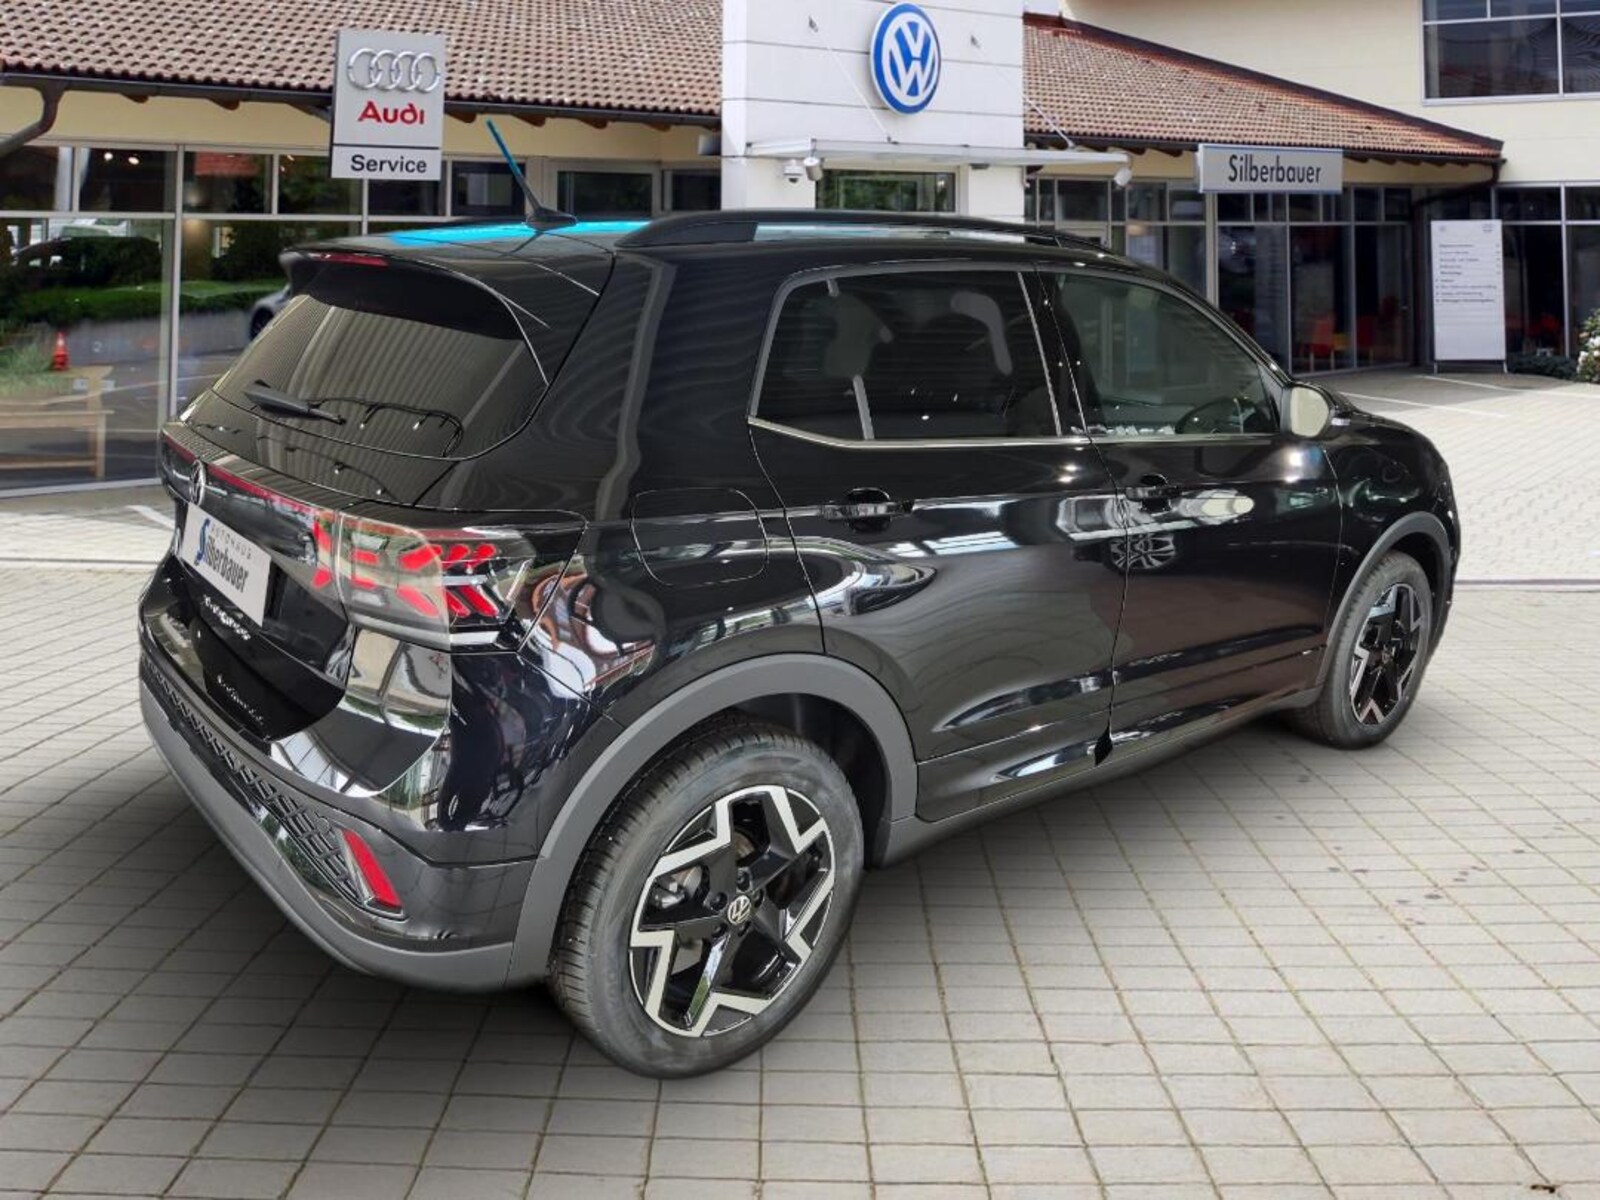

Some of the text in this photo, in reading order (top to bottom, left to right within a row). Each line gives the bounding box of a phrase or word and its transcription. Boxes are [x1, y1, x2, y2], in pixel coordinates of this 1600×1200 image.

[357, 101, 425, 125] Audi
[351, 154, 427, 173] Service
[1228, 153, 1322, 183] Silberbauer
